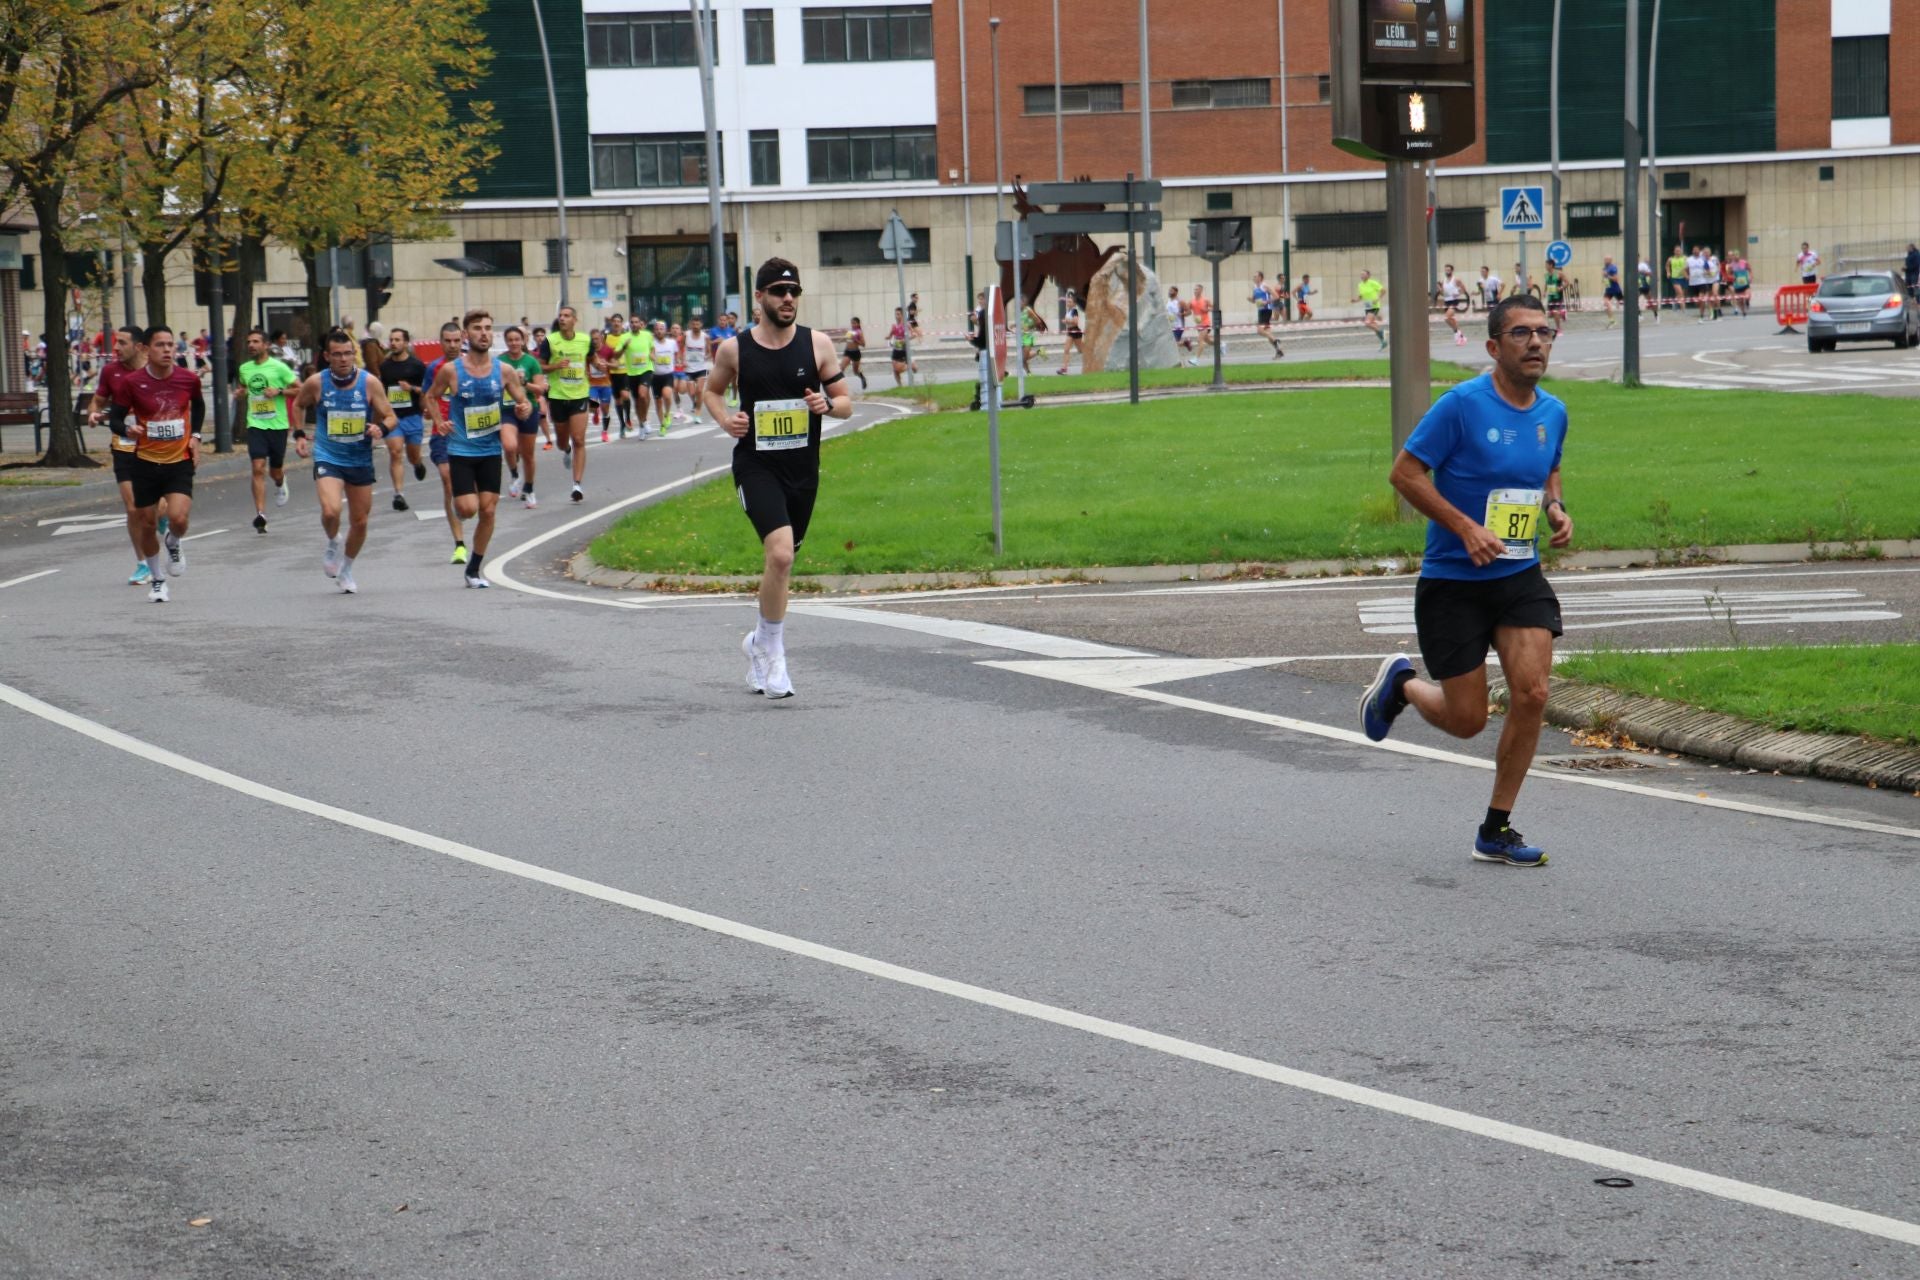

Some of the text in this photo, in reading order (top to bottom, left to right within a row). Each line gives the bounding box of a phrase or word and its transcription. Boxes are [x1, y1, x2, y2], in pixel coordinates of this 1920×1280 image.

[1385, 22, 1405, 39] LEÓN
[1448, 25, 1456, 38] 19
[342, 422, 352, 434] 61
[477, 415, 491, 428] 60
[773, 416, 793, 435] 110
[157, 425, 175, 437] 961
[1508, 513, 1529, 538] 87
